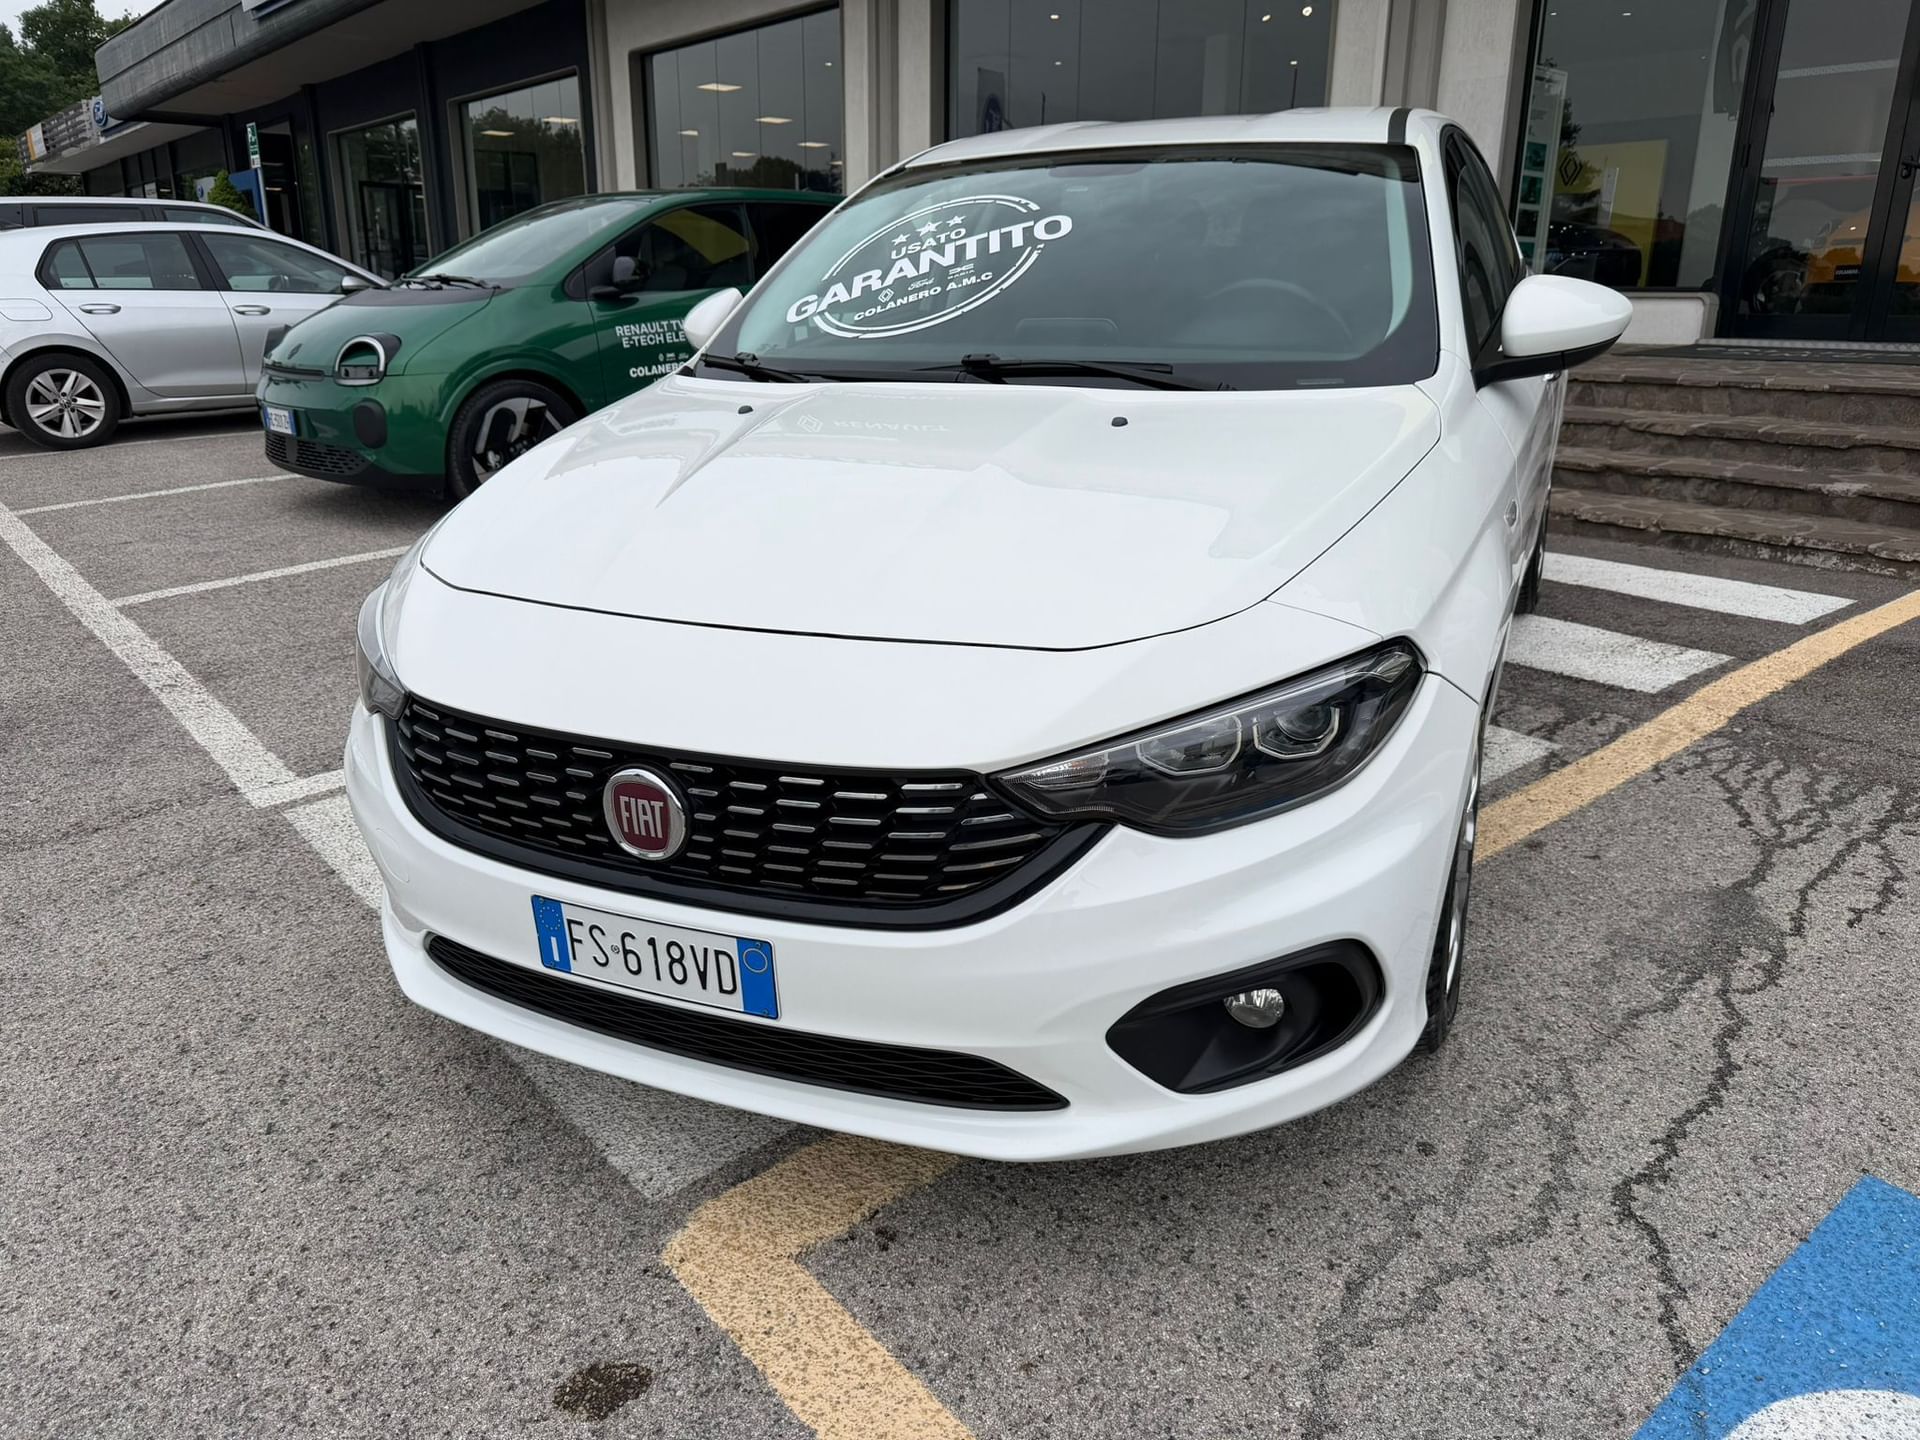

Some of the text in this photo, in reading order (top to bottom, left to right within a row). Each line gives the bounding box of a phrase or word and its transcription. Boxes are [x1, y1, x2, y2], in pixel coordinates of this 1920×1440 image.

[891, 227, 967, 260] USATO
[786, 215, 1073, 323] GARANTITO
[854, 286, 942, 321] COLANERO
[615, 320, 669, 337] RENAULT
[622, 331, 686, 348] E-TECH ELE
[619, 795, 664, 839] FIAT
